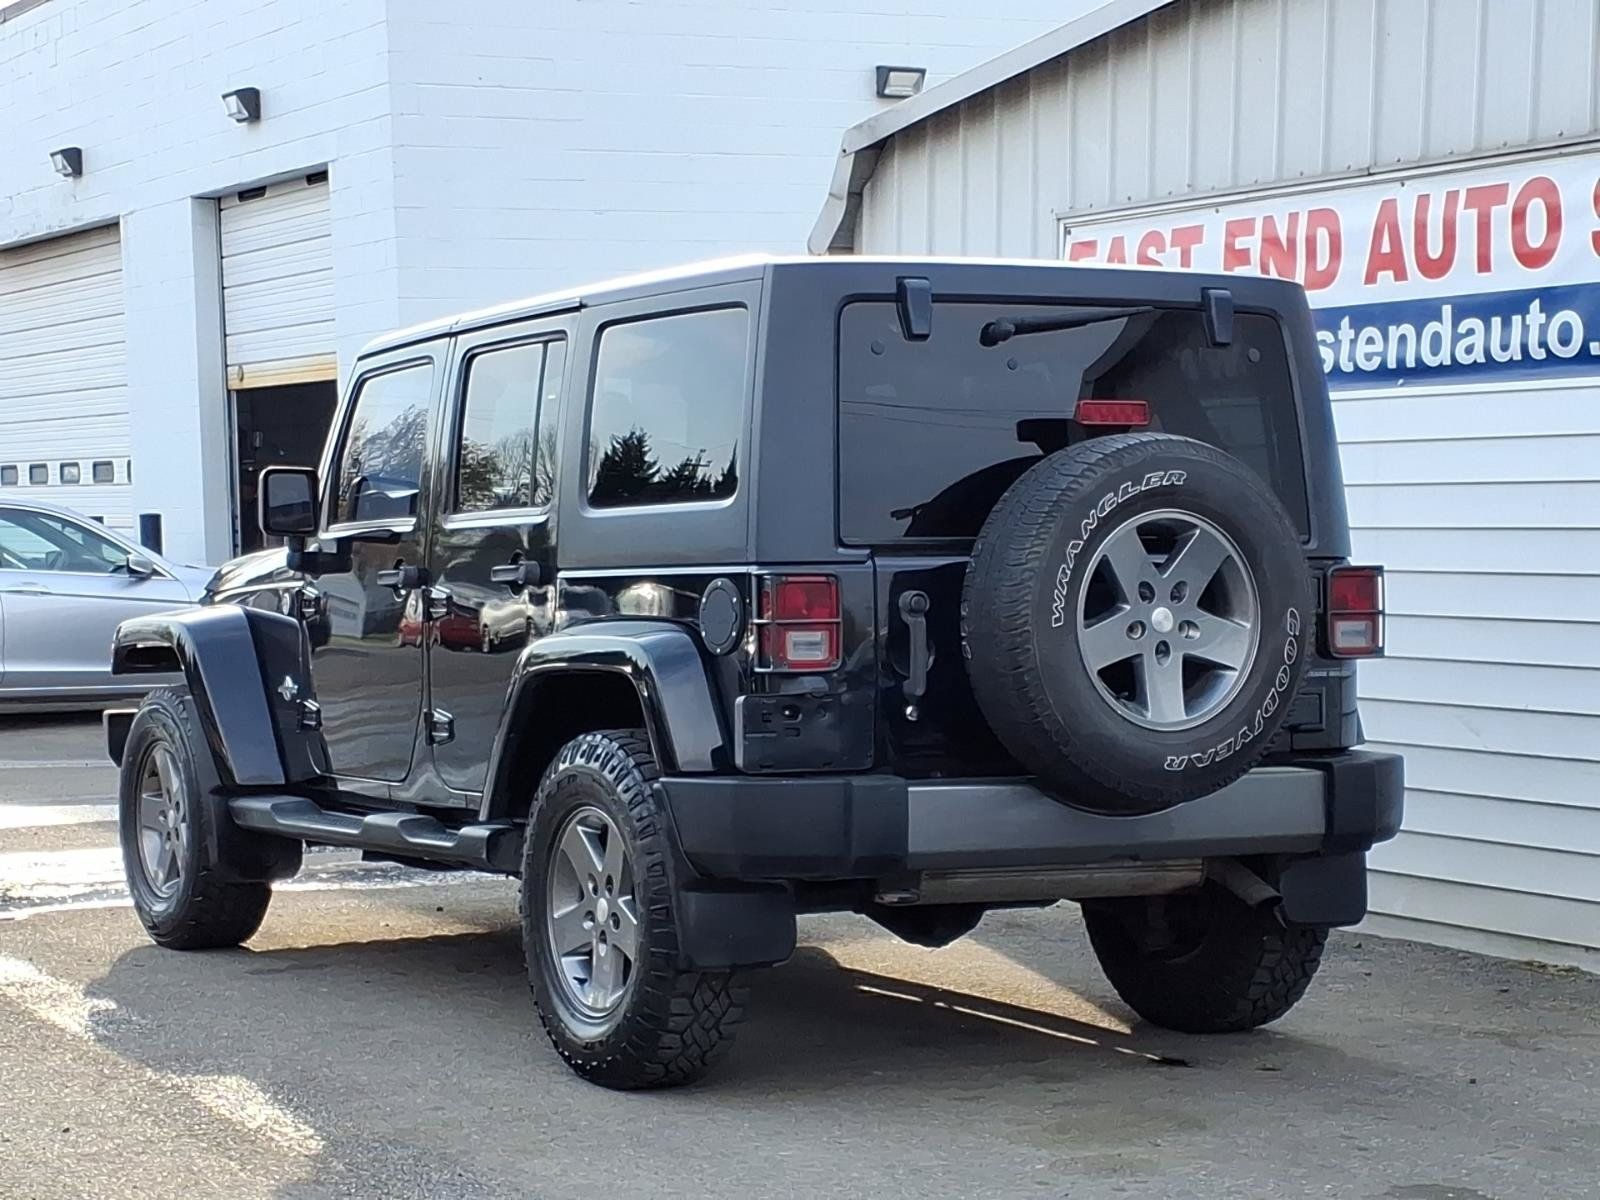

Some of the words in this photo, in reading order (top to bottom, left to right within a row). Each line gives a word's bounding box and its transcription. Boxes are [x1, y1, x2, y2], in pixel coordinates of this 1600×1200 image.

[1223, 207, 1342, 291] END
[1363, 176, 1562, 285] AUTO
[1052, 470, 1187, 627] WRANGLER
[1164, 607, 1300, 770] GOODYEAR
